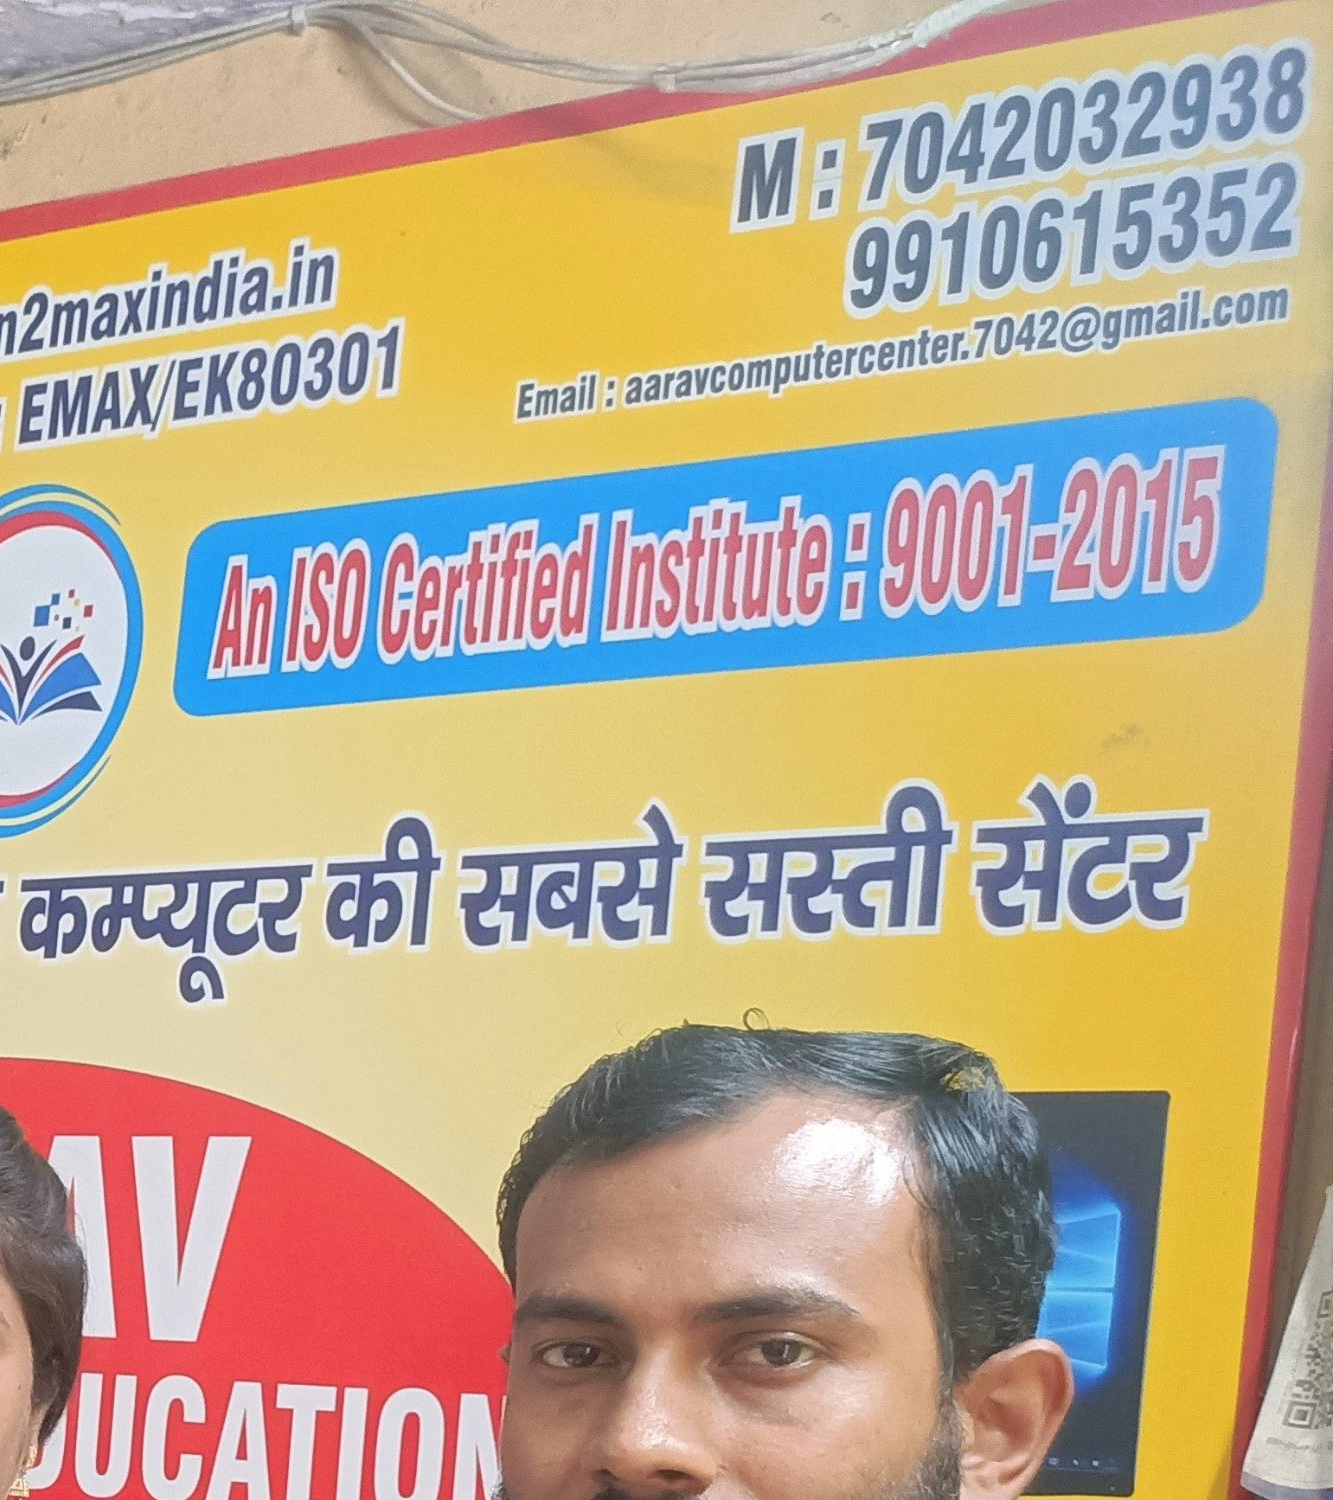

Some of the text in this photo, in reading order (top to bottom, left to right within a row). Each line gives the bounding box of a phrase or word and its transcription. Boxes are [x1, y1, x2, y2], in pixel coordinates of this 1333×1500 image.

[737, 136, 799, 223] M
[863, 46, 1309, 200] 7042032938
[848, 162, 1297, 309] 9910615352
[18, 325, 402, 444] EMAX/EK80301
[516, 373, 596, 420] Email
[624, 286, 1289, 407] aaravcomputercenter.7042@gmail.com
[212, 563, 273, 671] An
[286, 547, 366, 664] ISO
[380, 523, 593, 656] Certified
[604, 506, 828, 635] Institute
[882, 455, 1219, 608] 9001-2015
[20, 862, 313, 1002] कम्प्यूटर
[326, 816, 439, 949] की
[460, 806, 684, 946] सबसे
[703, 781, 956, 936] सस्ती
[972, 778, 1207, 932] सेंटर
